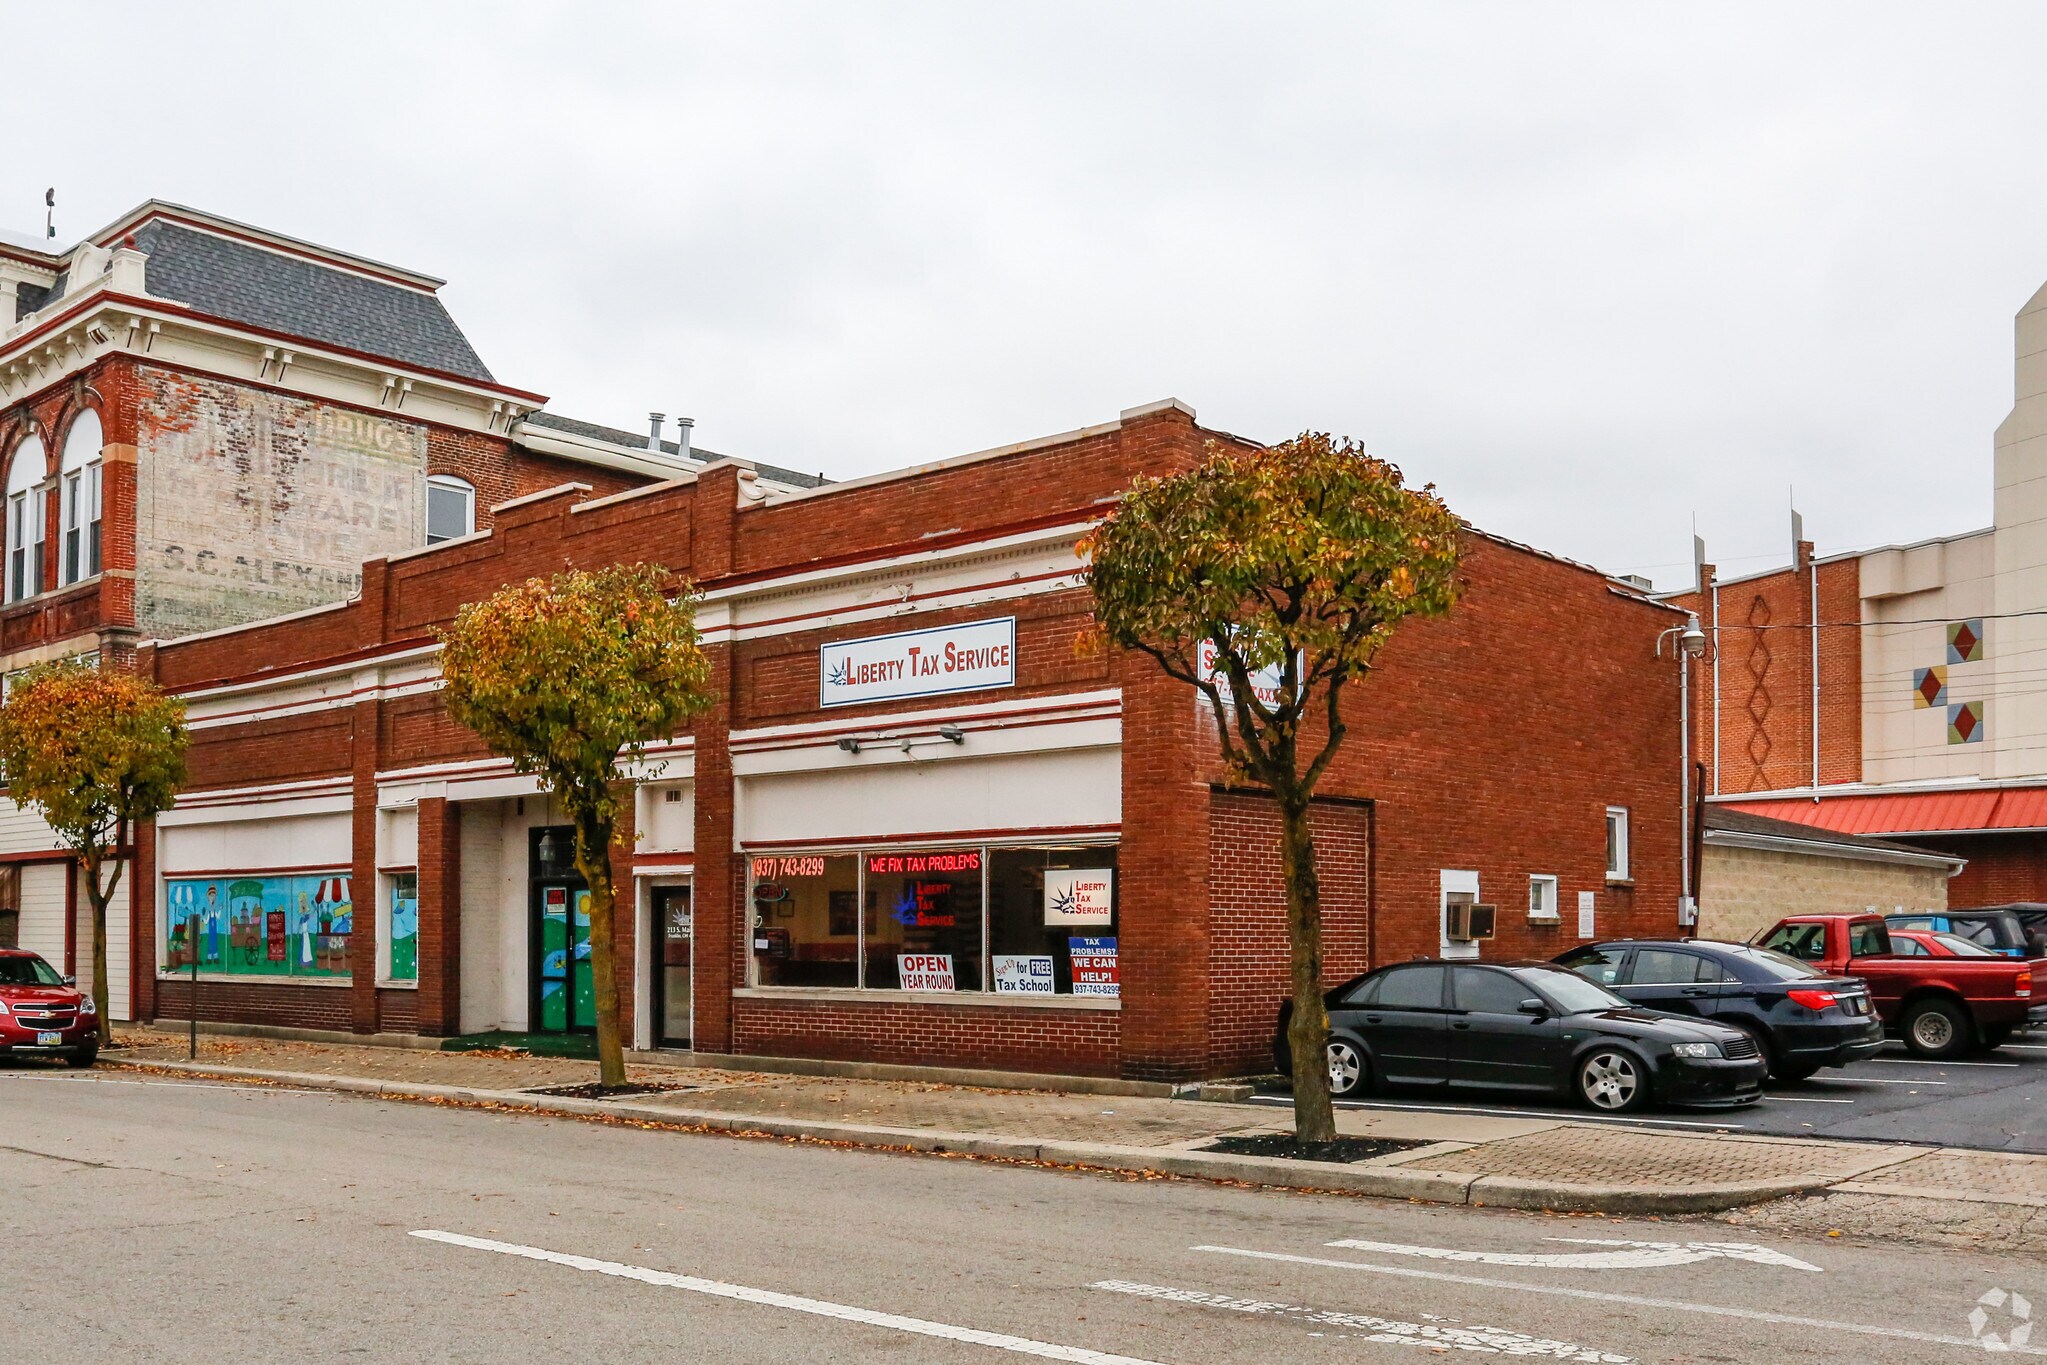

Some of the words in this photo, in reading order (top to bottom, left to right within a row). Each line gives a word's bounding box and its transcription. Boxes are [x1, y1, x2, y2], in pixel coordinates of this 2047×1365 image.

[846, 656, 904, 686] LIBERTY
[908, 647, 940, 677] TAX
[944, 641, 1010, 673] SERVICE
[752, 857, 777, 880] (937)
[779, 857, 824, 876] 743-8299
[870, 858, 886, 873] WE
[888, 857, 903, 872] FIX
[906, 856, 926, 872] TAX
[928, 853, 979, 872] PROBLEMS
[916, 881, 952, 895] LIBERTY
[1075, 880, 1107, 891] LIBERTY
[916, 896, 934, 910] TAX
[1075, 892, 1091, 903] TAX
[1075, 904, 1109, 915] SERVICE
[916, 911, 955, 927] SERVICE
[1084, 938, 1100, 946] TAX
[1071, 948, 1116, 956] PROBLEMS?
[904, 956, 948, 972] OPEN
[1016, 961, 1028, 974] for
[1031, 961, 1052, 975] FREE
[1073, 958, 1091, 968] WE
[1093, 958, 1117, 968] CAN
[901, 974, 924, 989] YEAR
[925, 975, 954, 990] ROUND
[1080, 972, 1112, 982] HELP!
[997, 978, 1016, 991] Tax
[1019, 978, 1052, 992] School
[1074, 984, 1120, 995] 937-743-8299
